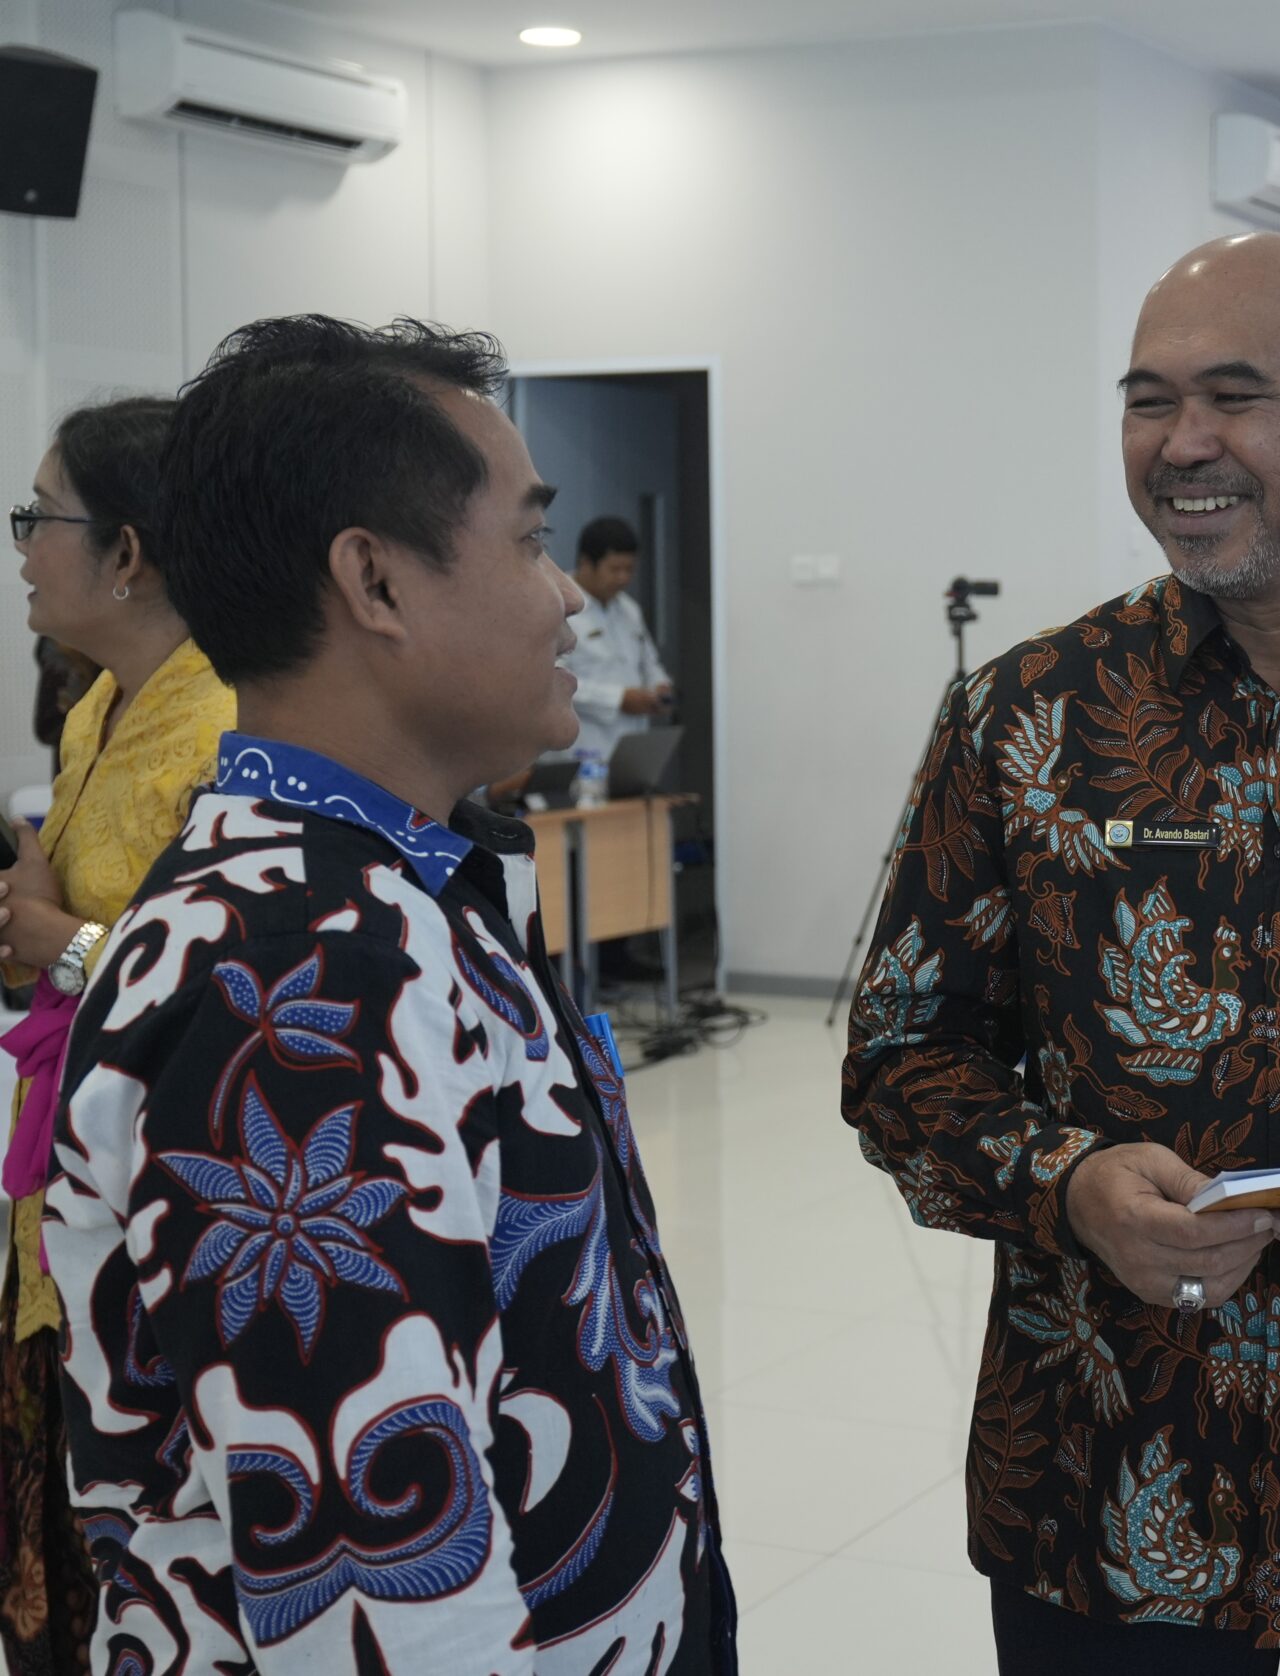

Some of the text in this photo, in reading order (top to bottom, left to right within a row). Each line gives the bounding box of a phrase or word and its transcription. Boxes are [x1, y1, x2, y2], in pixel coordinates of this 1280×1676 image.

[1143, 827, 1209, 840] Dr. Avando Bastari
